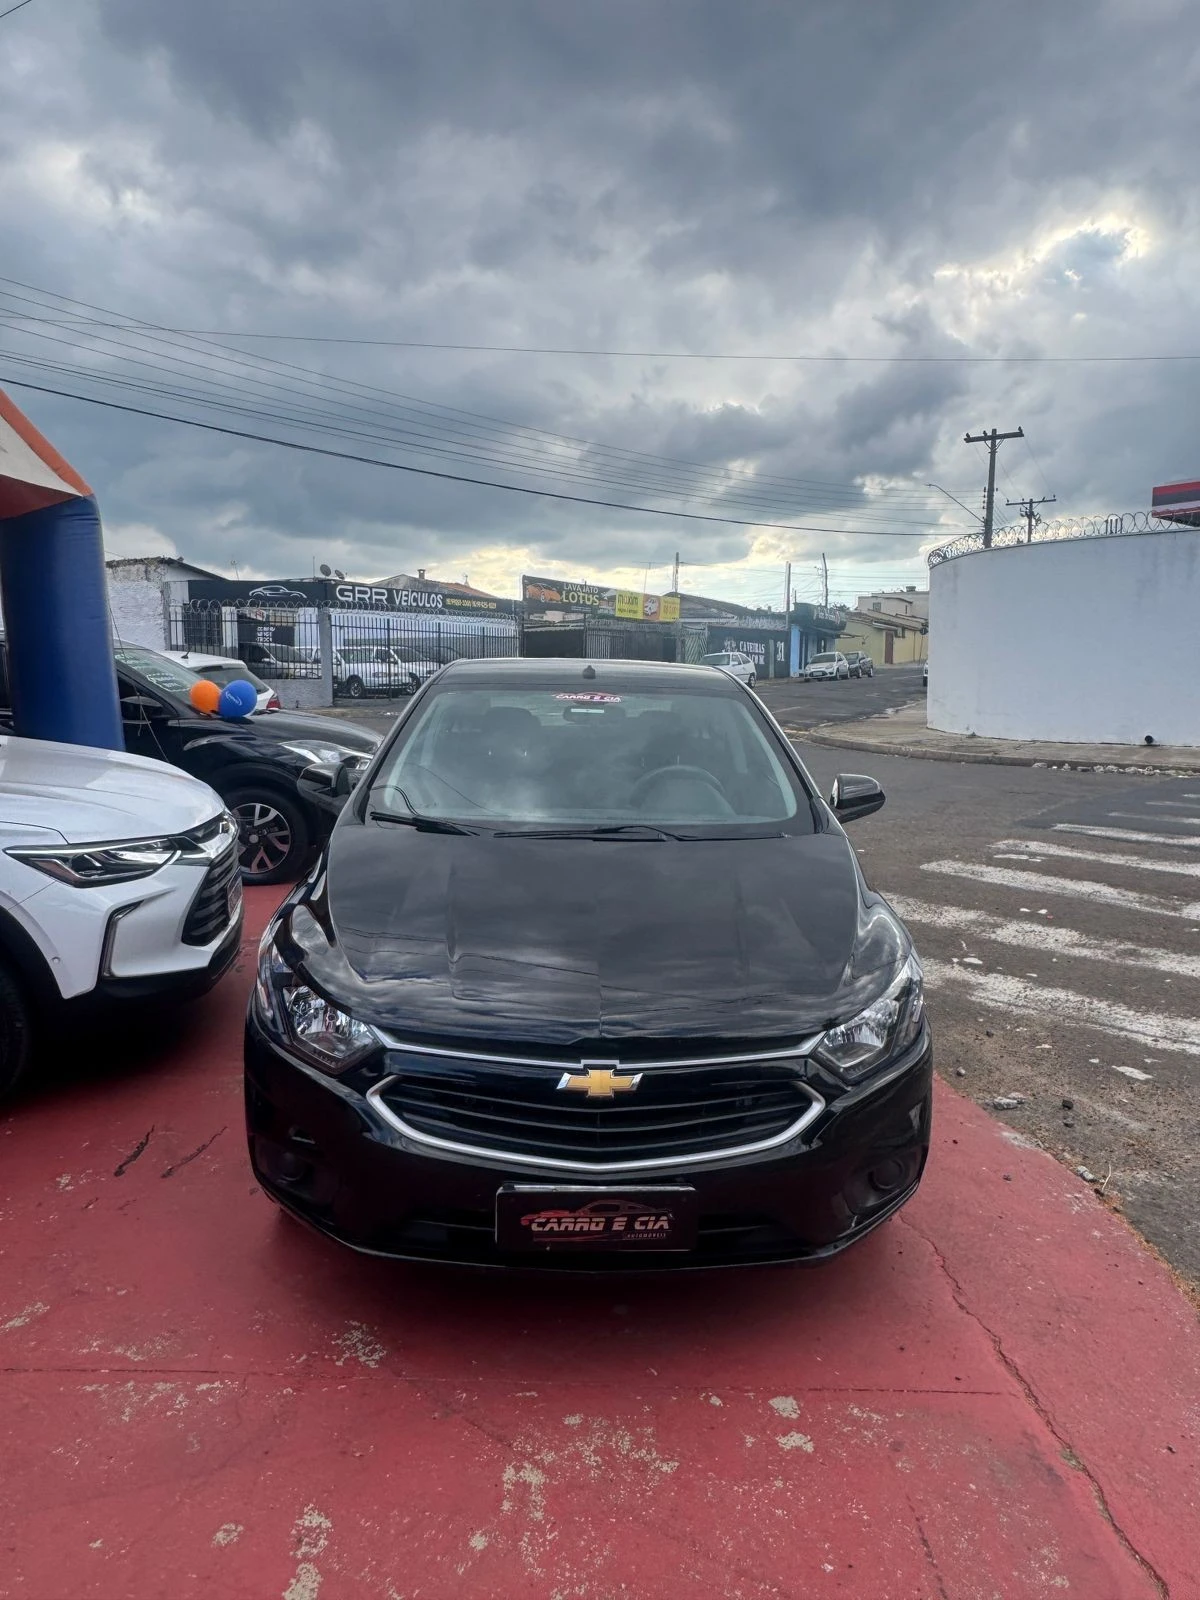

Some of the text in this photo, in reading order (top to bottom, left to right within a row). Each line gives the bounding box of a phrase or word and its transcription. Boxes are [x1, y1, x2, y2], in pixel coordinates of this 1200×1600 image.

[335, 585, 388, 605] GRR
[561, 591, 600, 606] LOTUS
[776, 641, 784, 661] 31
[531, 1215, 670, 1232] CARRO E CIA
